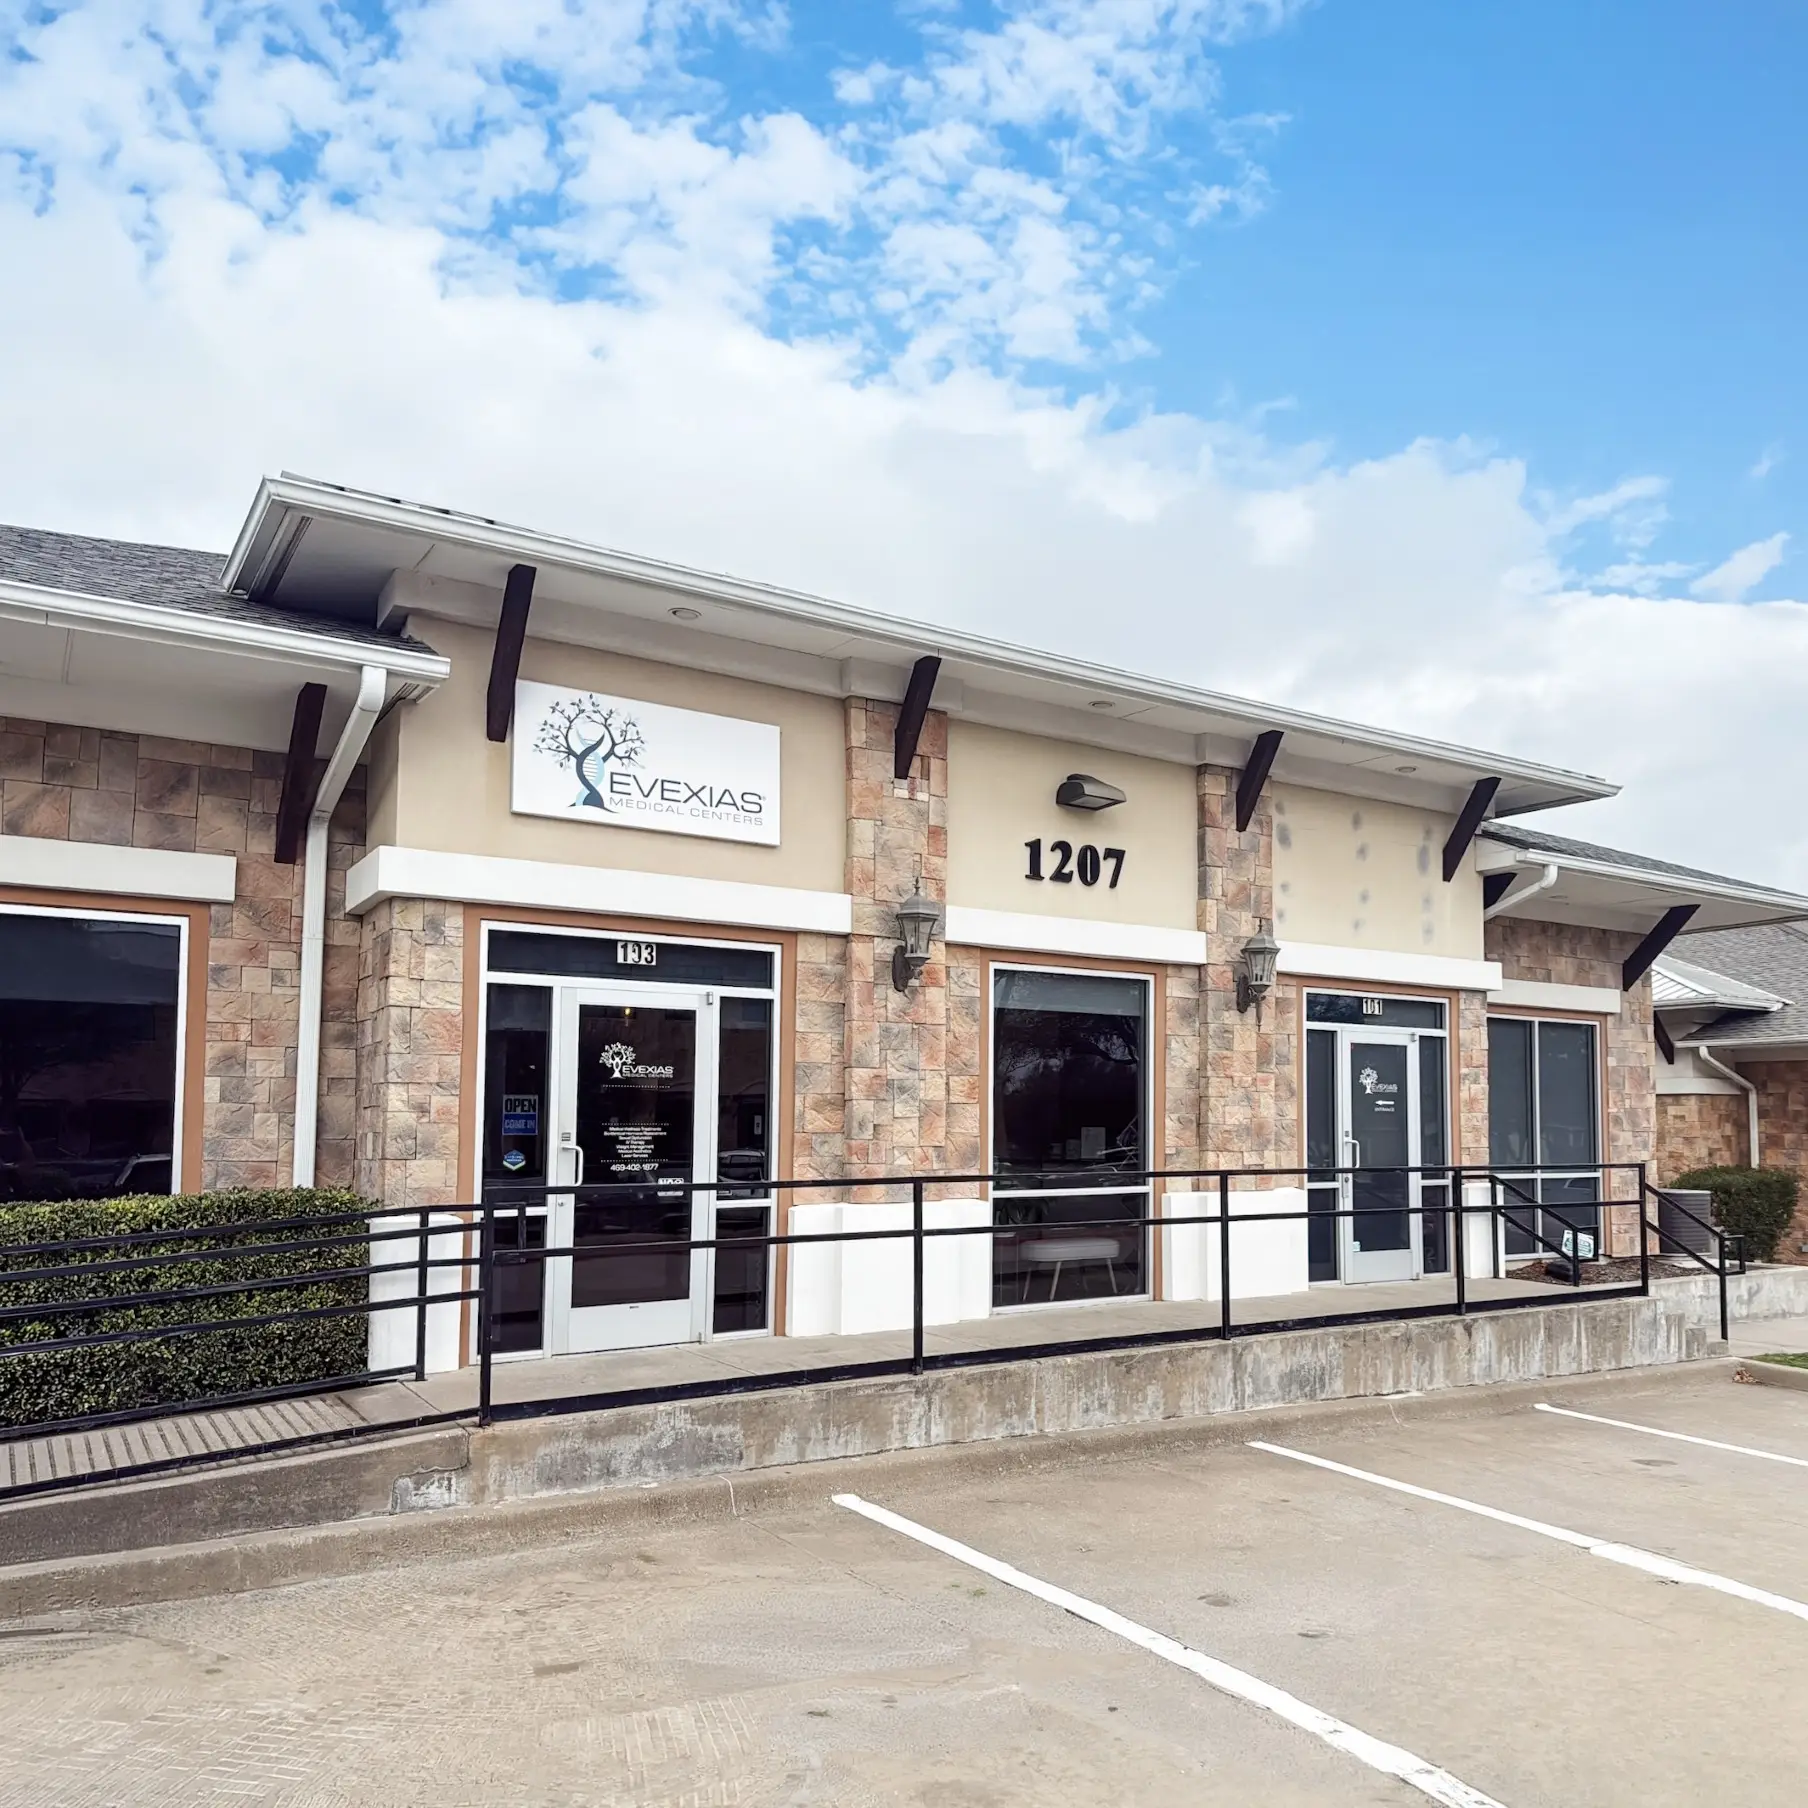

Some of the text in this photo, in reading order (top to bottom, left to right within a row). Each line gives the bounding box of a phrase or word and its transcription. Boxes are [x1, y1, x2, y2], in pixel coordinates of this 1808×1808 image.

[610, 771, 763, 814] EVEXIAS
[609, 796, 763, 826] MEDICAL CENTERS
[1024, 838, 1126, 889] 1207
[620, 942, 654, 964] 103
[1364, 997, 1381, 1014] 101
[622, 1065, 673, 1074] EVEXIAS
[505, 1098, 537, 1113] OPEN
[504, 1119, 535, 1129] COME IN
